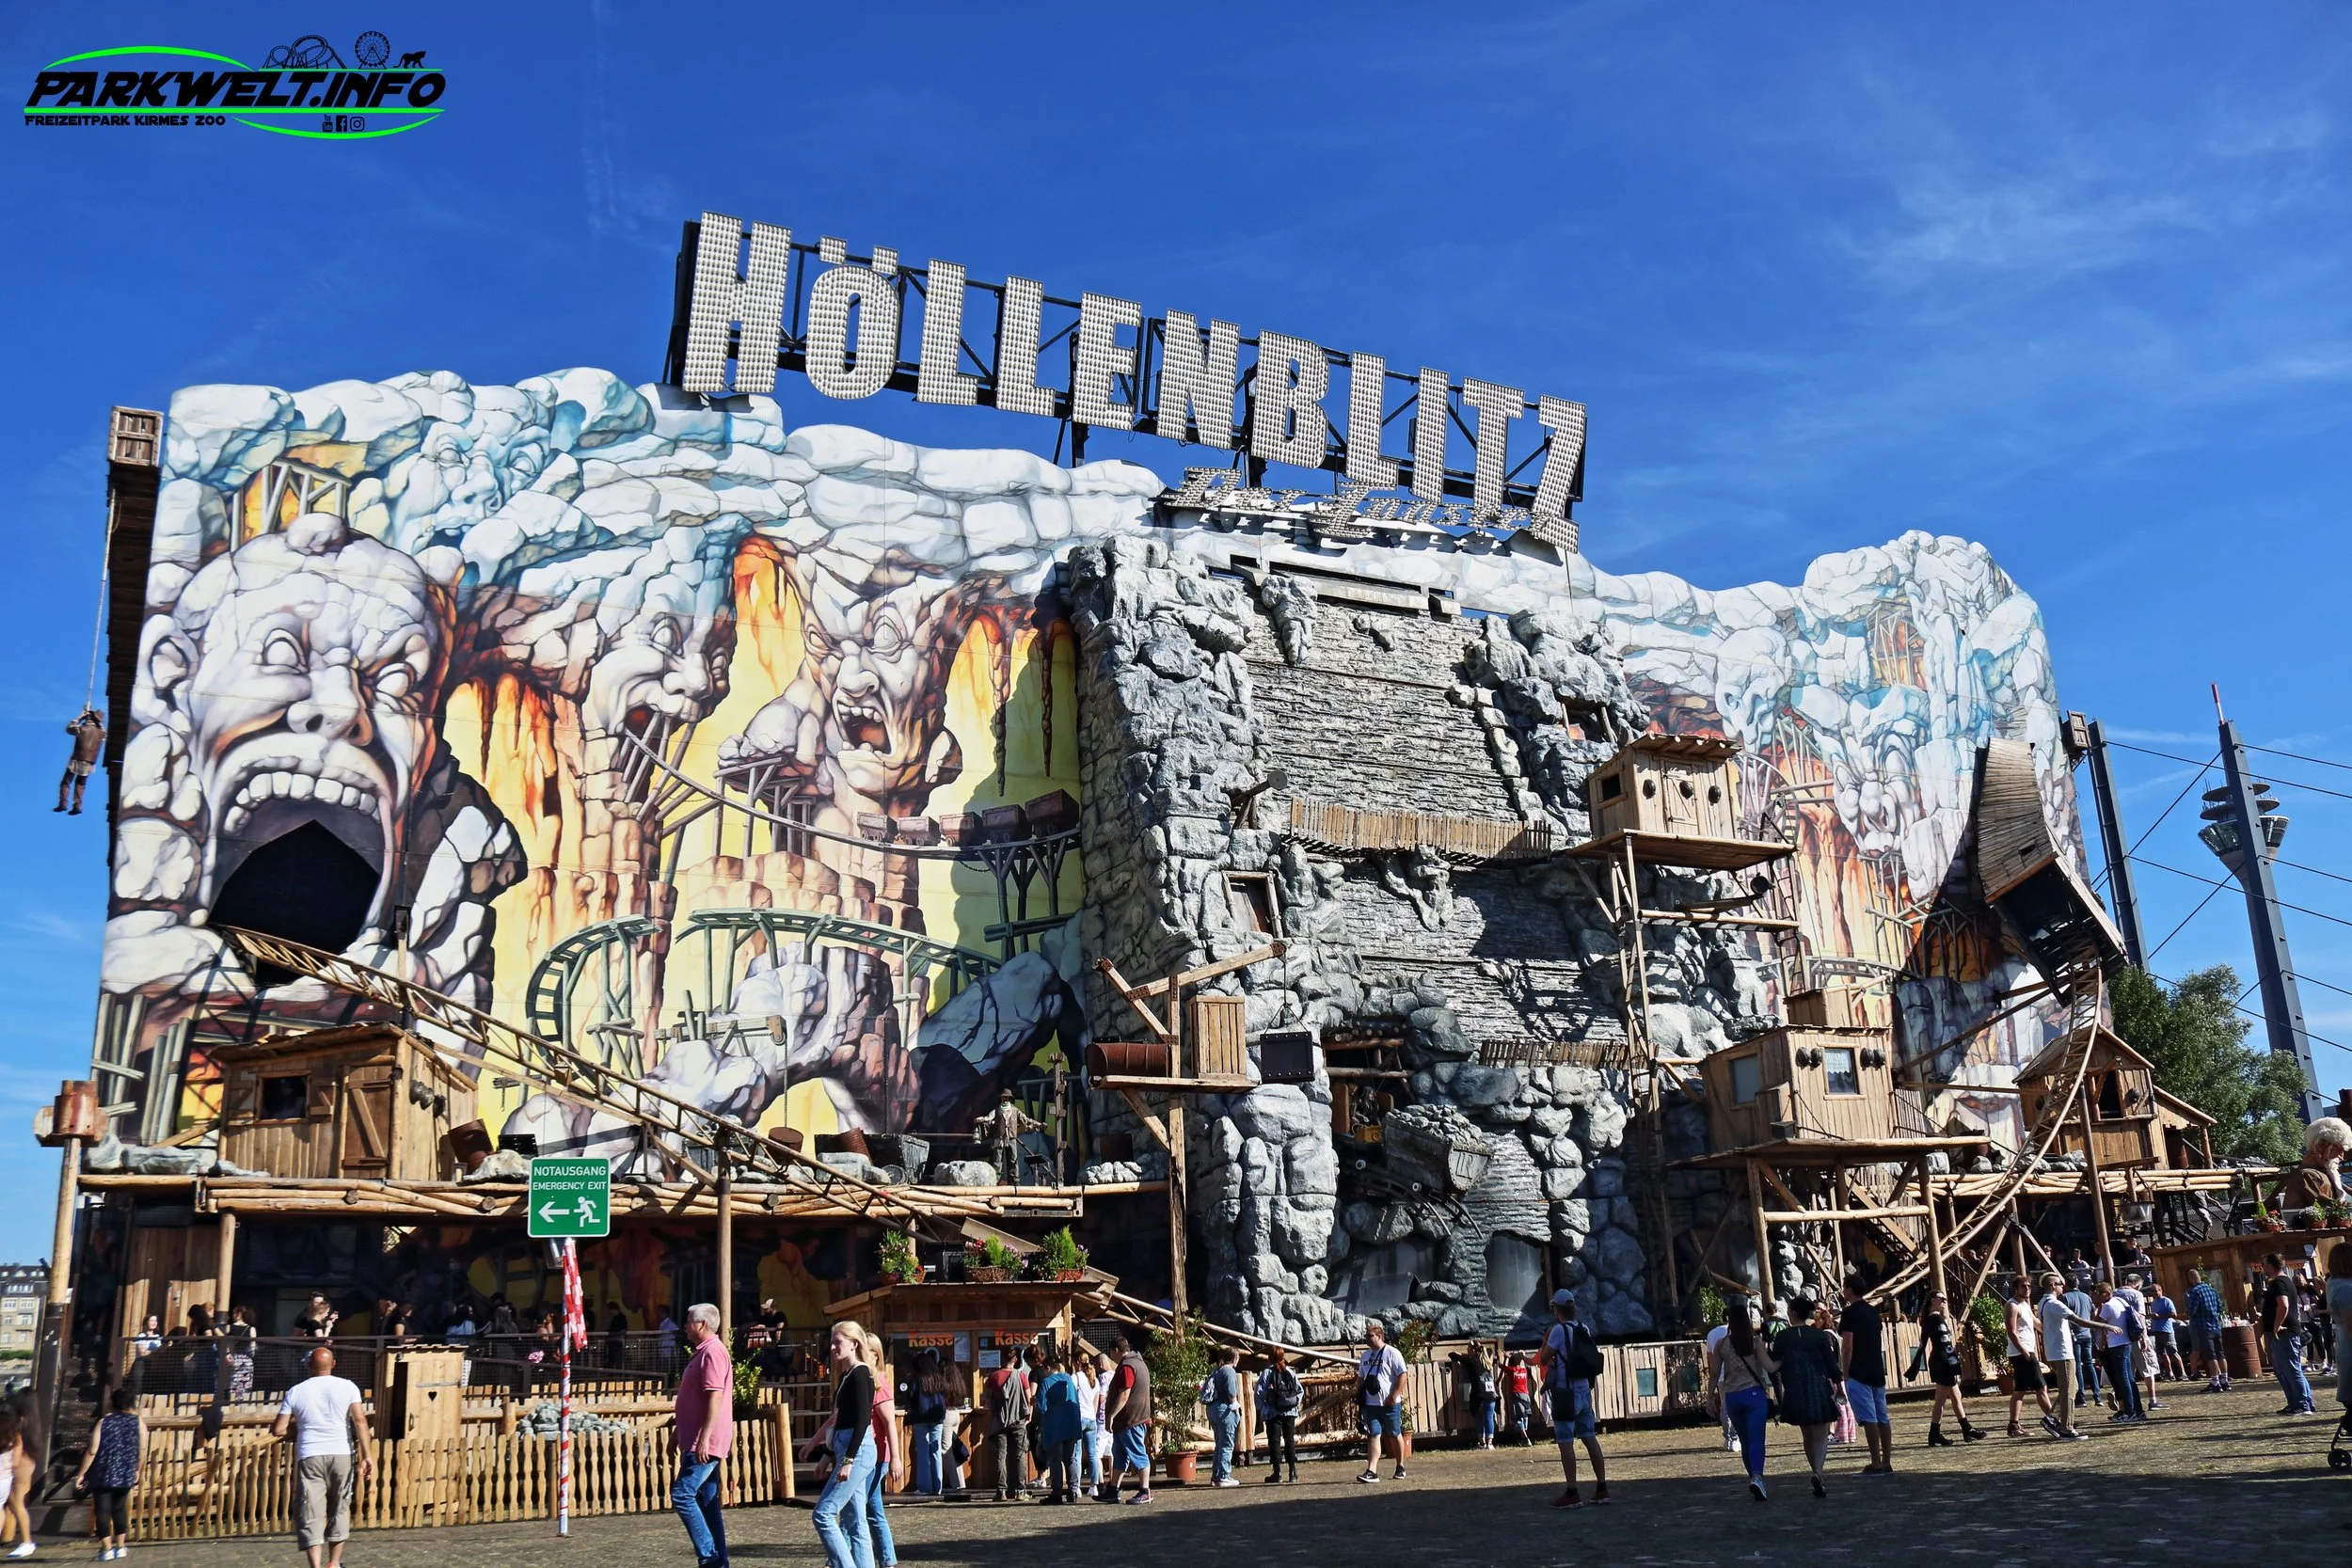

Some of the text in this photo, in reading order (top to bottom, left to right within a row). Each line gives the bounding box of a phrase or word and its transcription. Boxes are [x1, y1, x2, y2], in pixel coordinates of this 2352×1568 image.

[682, 209, 1587, 554] HÖLLENBLITZ
[533, 1165, 607, 1177] NOTAUSGANG
[532, 1181, 607, 1191] EMERGENCY EXIT
[908, 1328, 954, 1347] Kasse
